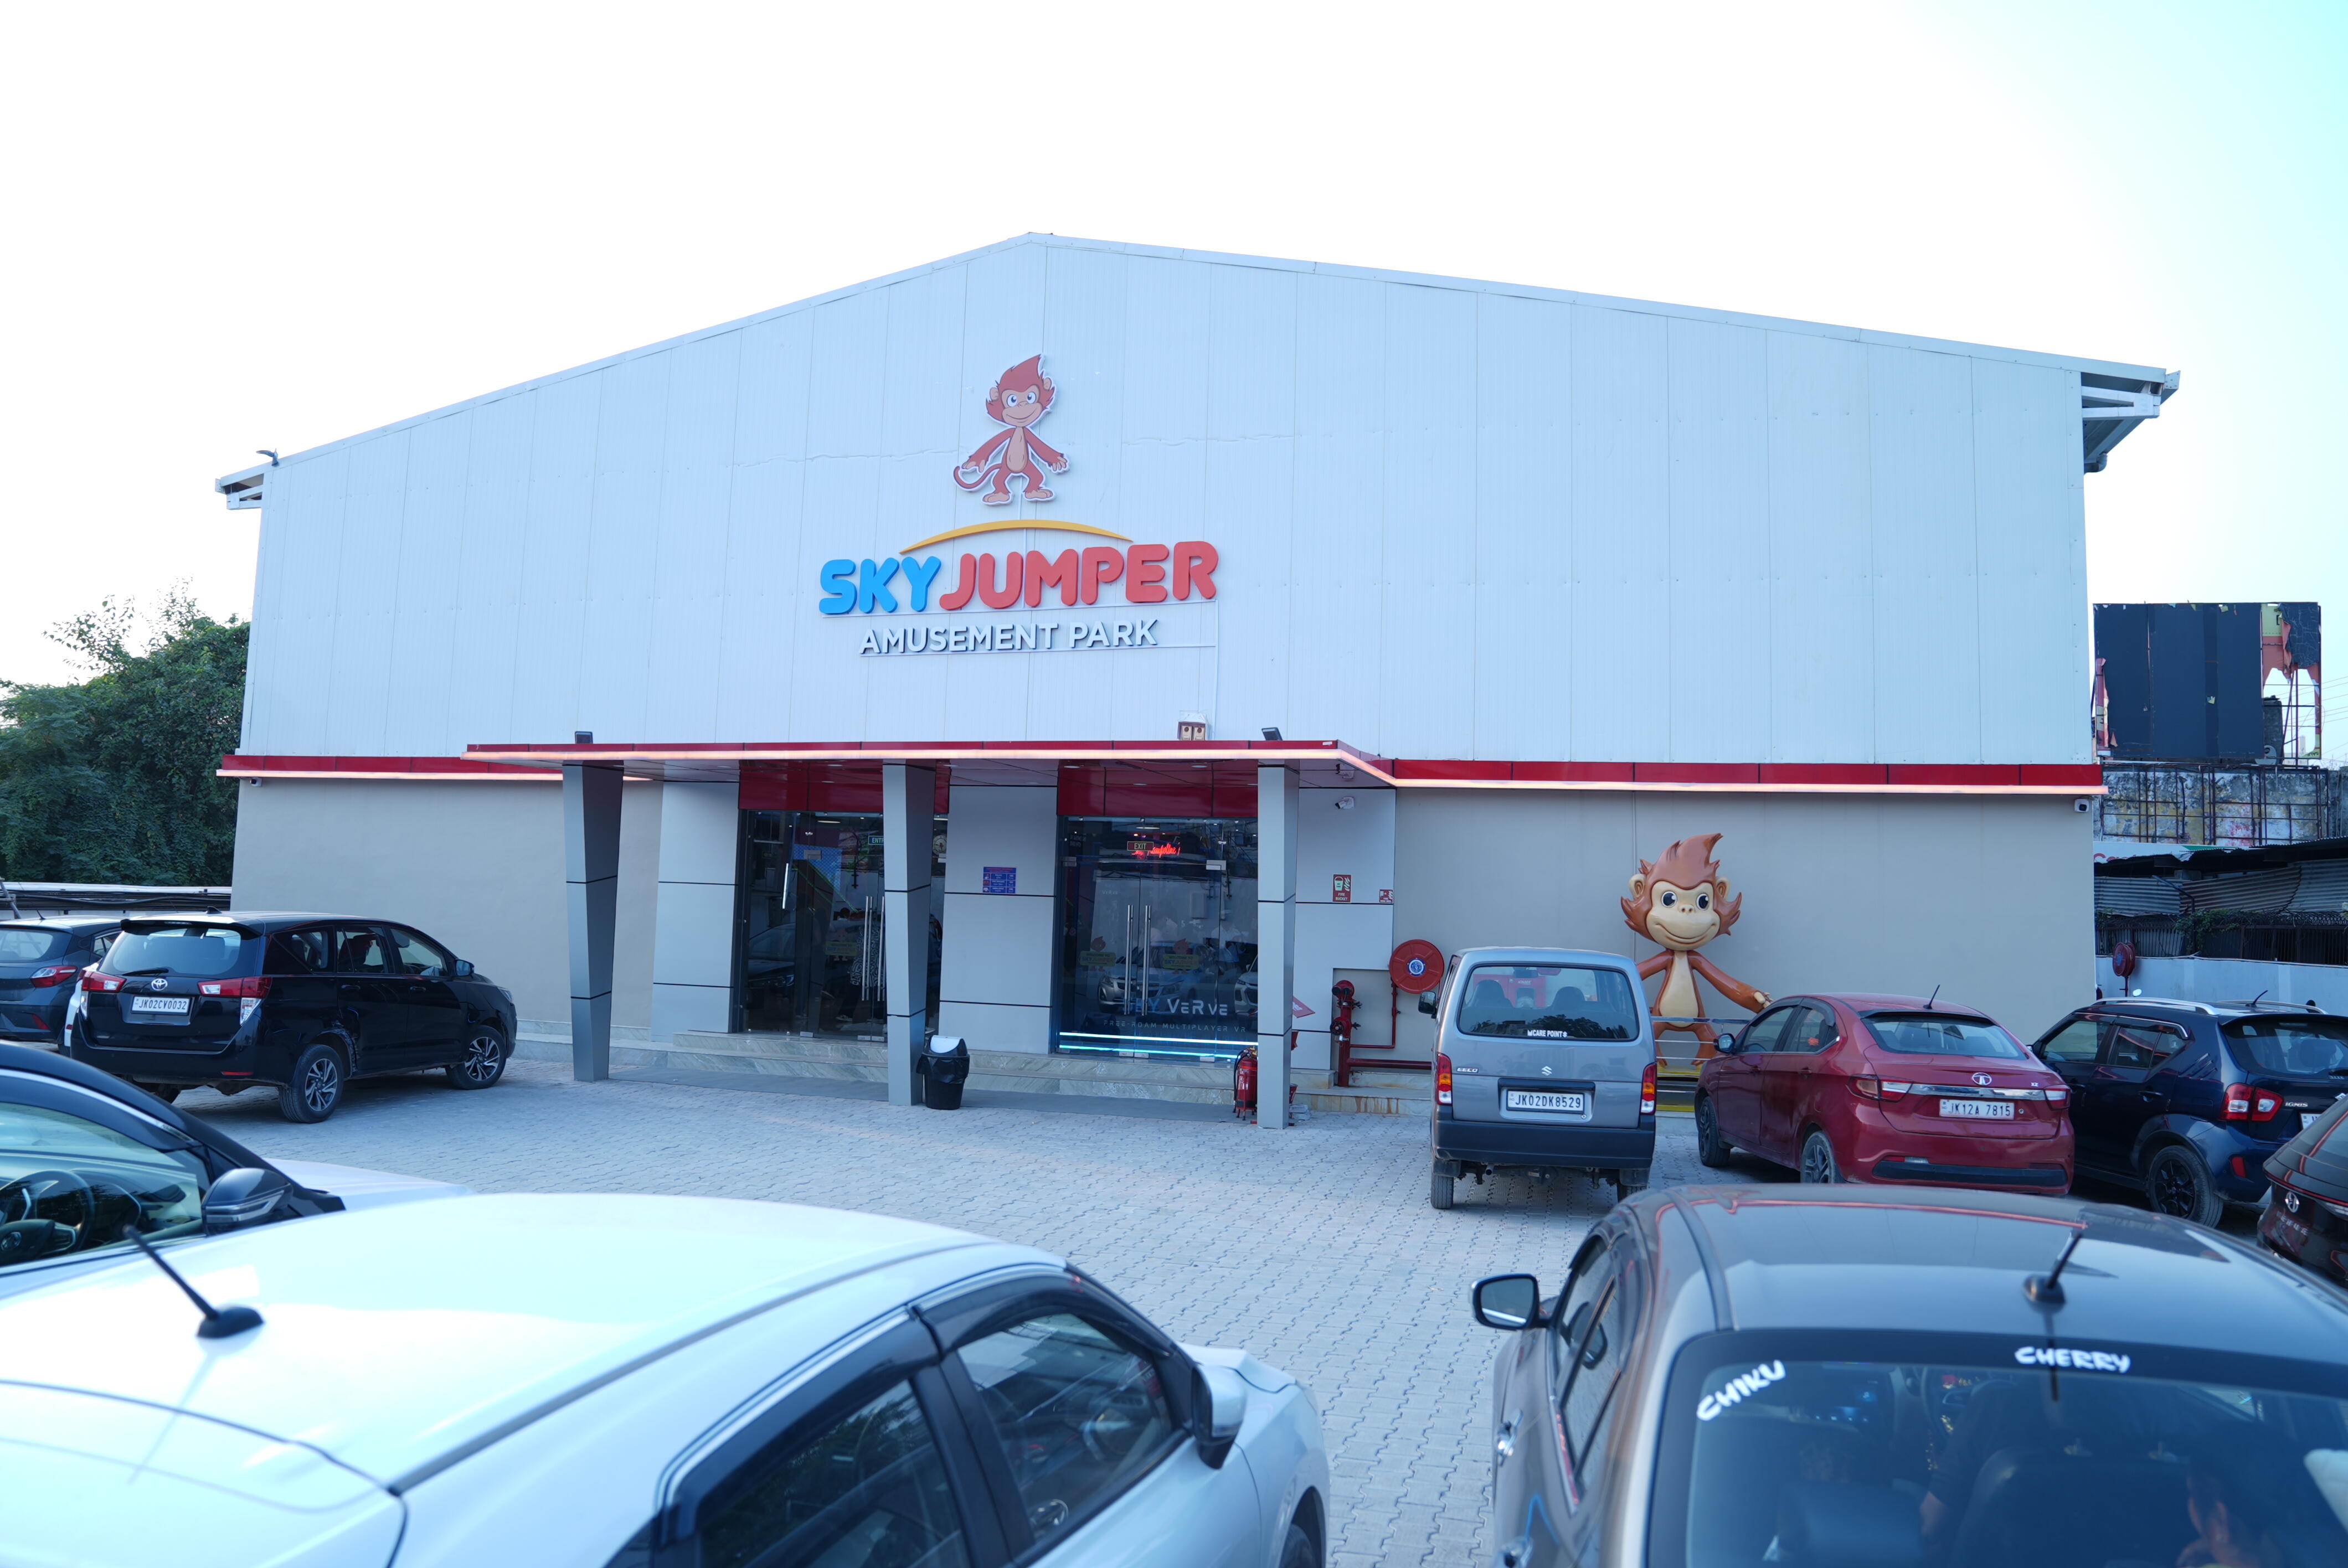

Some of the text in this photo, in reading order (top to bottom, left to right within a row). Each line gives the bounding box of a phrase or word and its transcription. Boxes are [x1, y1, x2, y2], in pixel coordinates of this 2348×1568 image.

[859, 618, 1158, 654] AMUSEMENT PARK
[139, 999, 187, 1010] JK02CV0032
[1103, 1020, 1157, 1028] FREE-ROAM
[1162, 1023, 1228, 1031] MULTIPLAYER
[1515, 1094, 1580, 1108] JK02DK8529
[1948, 1103, 2011, 1117] JK12A 7815
[2014, 1346, 2131, 1374] CHERRY
[1696, 1359, 1786, 1422] CHIKU
